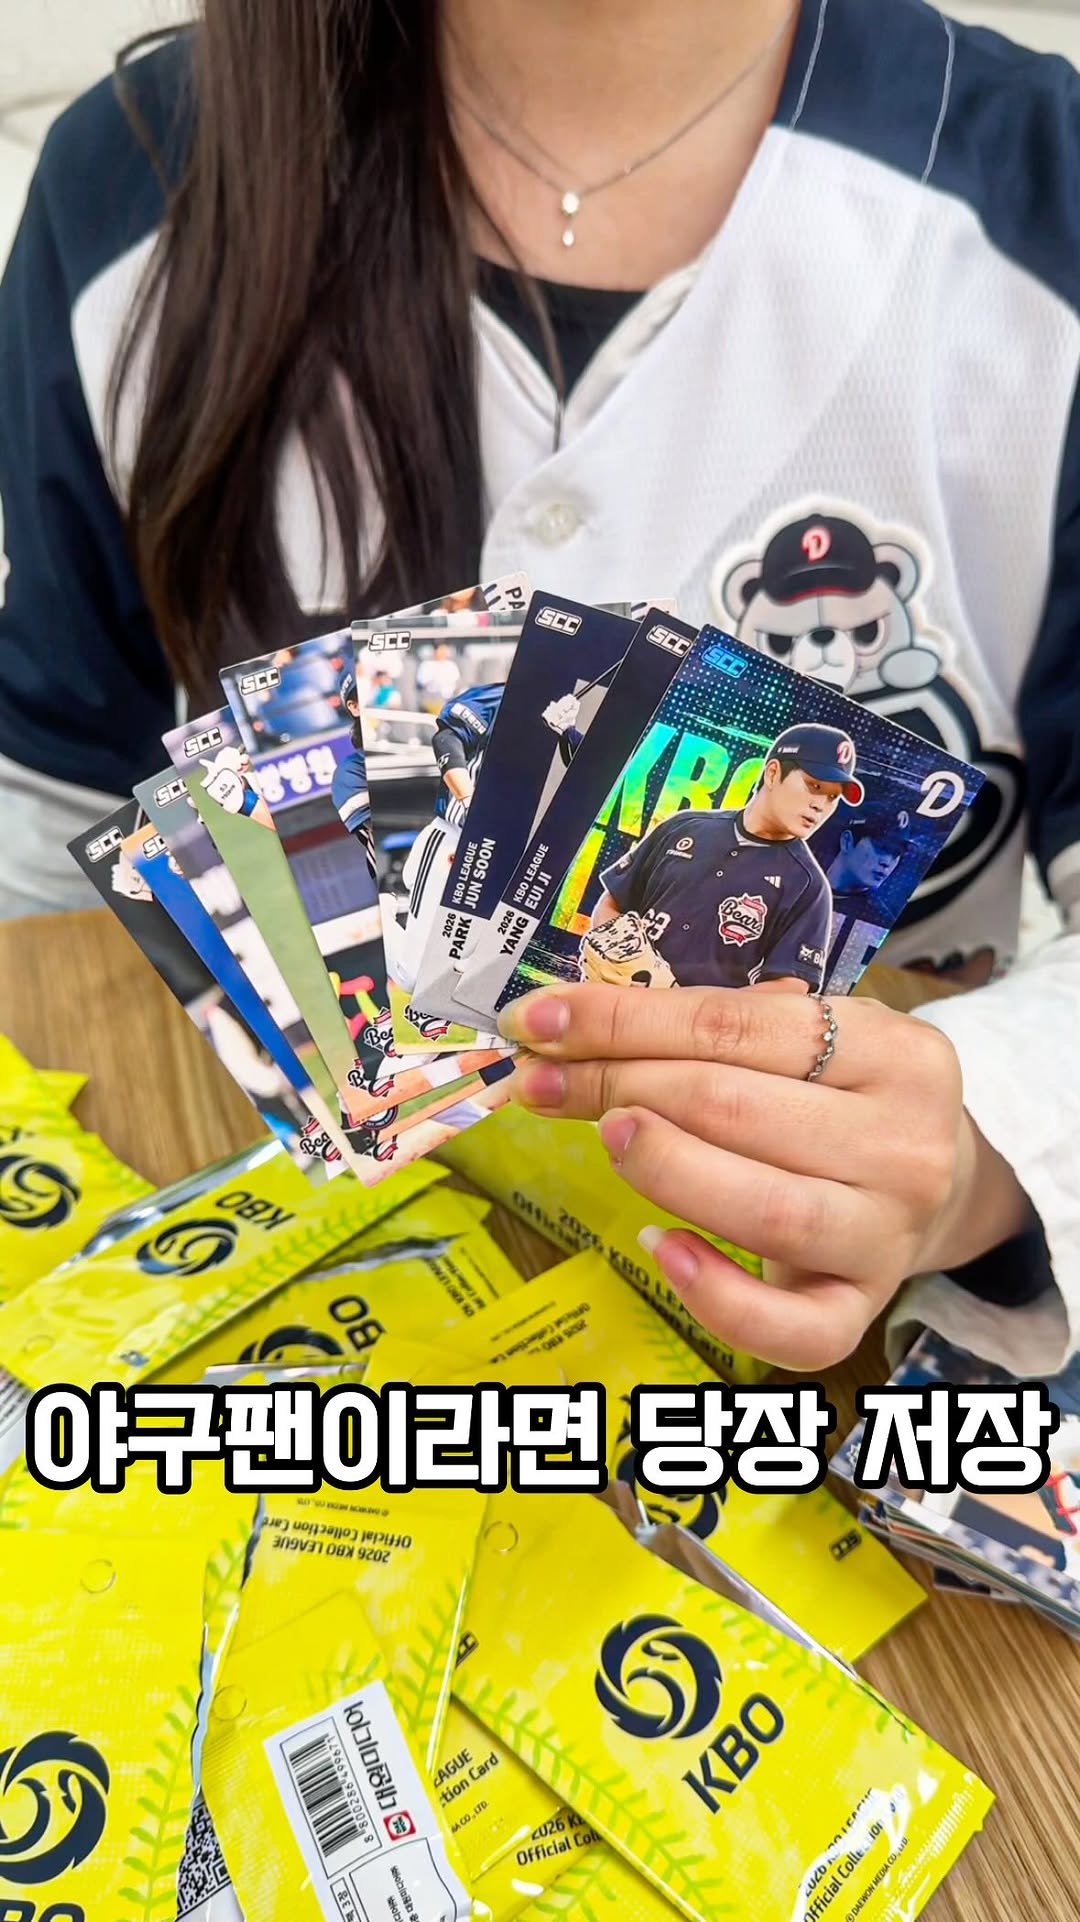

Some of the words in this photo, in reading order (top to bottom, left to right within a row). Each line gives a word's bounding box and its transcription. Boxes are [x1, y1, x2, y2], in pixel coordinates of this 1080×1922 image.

[537, 608, 582, 634] SCC
[369, 632, 411, 651] SCC
[647, 627, 692, 656] SCC
[702, 646, 748, 678] SCC
[240, 667, 281, 695] SCC
[184, 727, 223, 758] SCC
[916, 770, 966, 819] D
[86, 828, 124, 861] SCC
[473, 837, 497, 879] SOON
[442, 912, 457, 938] 2026
[452, 882, 465, 904] KBO
[459, 841, 478, 880] LEAGUE
[464, 881, 483, 909] JUN
[497, 910, 515, 935] 2026
[512, 881, 529, 903] KBO
[523, 843, 549, 882] LEAGUE
[500, 916, 530, 955] YANG
[524, 887, 546, 910] EUI
[537, 871, 552, 886] JI
[721, 898, 763, 934] Bears
[449, 916, 472, 960] PARK
[215, 1190, 297, 1231] KBO
[608, 1246, 650, 1287] KBO
[272, 1534, 324, 1553] LEAGUE
[292, 1520, 358, 1542] Collection
[361, 1530, 412, 1549] Official
[326, 1542, 355, 1558] KBO
[357, 1546, 391, 1563] 2026
[343, 1700, 397, 1811] 대원미디어
[468, 1751, 499, 1781] Card
[681, 1691, 785, 1815] KBO
[363, 1834, 374, 1844] 8
[532, 1818, 565, 1840] 2026
[516, 1835, 572, 1866] Official
[803, 1875, 843, 1922] Official
[837, 1819, 883, 1879] Colleion
[852, 1884, 875, 1914] DAEWON
[873, 1863, 890, 1887] MEDIA
